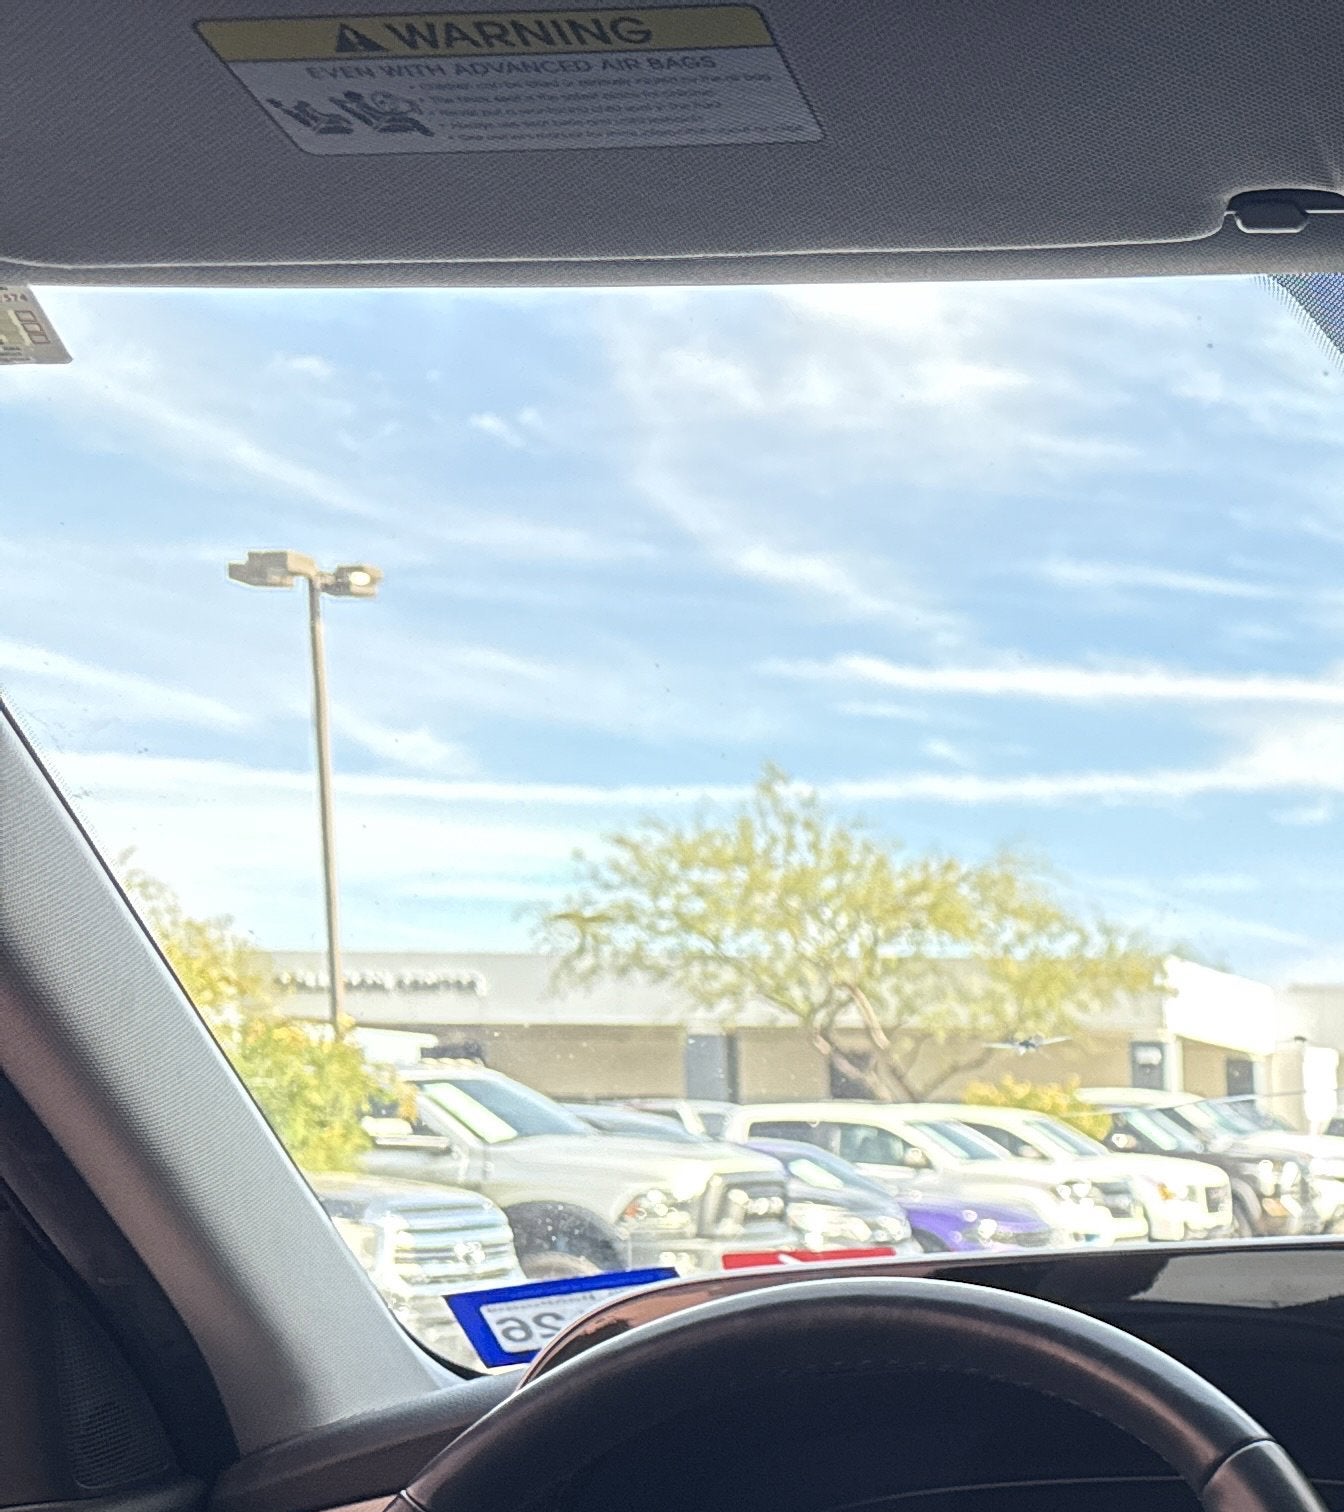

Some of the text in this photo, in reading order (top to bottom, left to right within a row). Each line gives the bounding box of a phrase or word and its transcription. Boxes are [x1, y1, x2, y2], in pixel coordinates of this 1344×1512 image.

[385, 16, 652, 51] WARNING
[307, 54, 716, 81] EVEN WITH ADVANCED AIR BAGS
